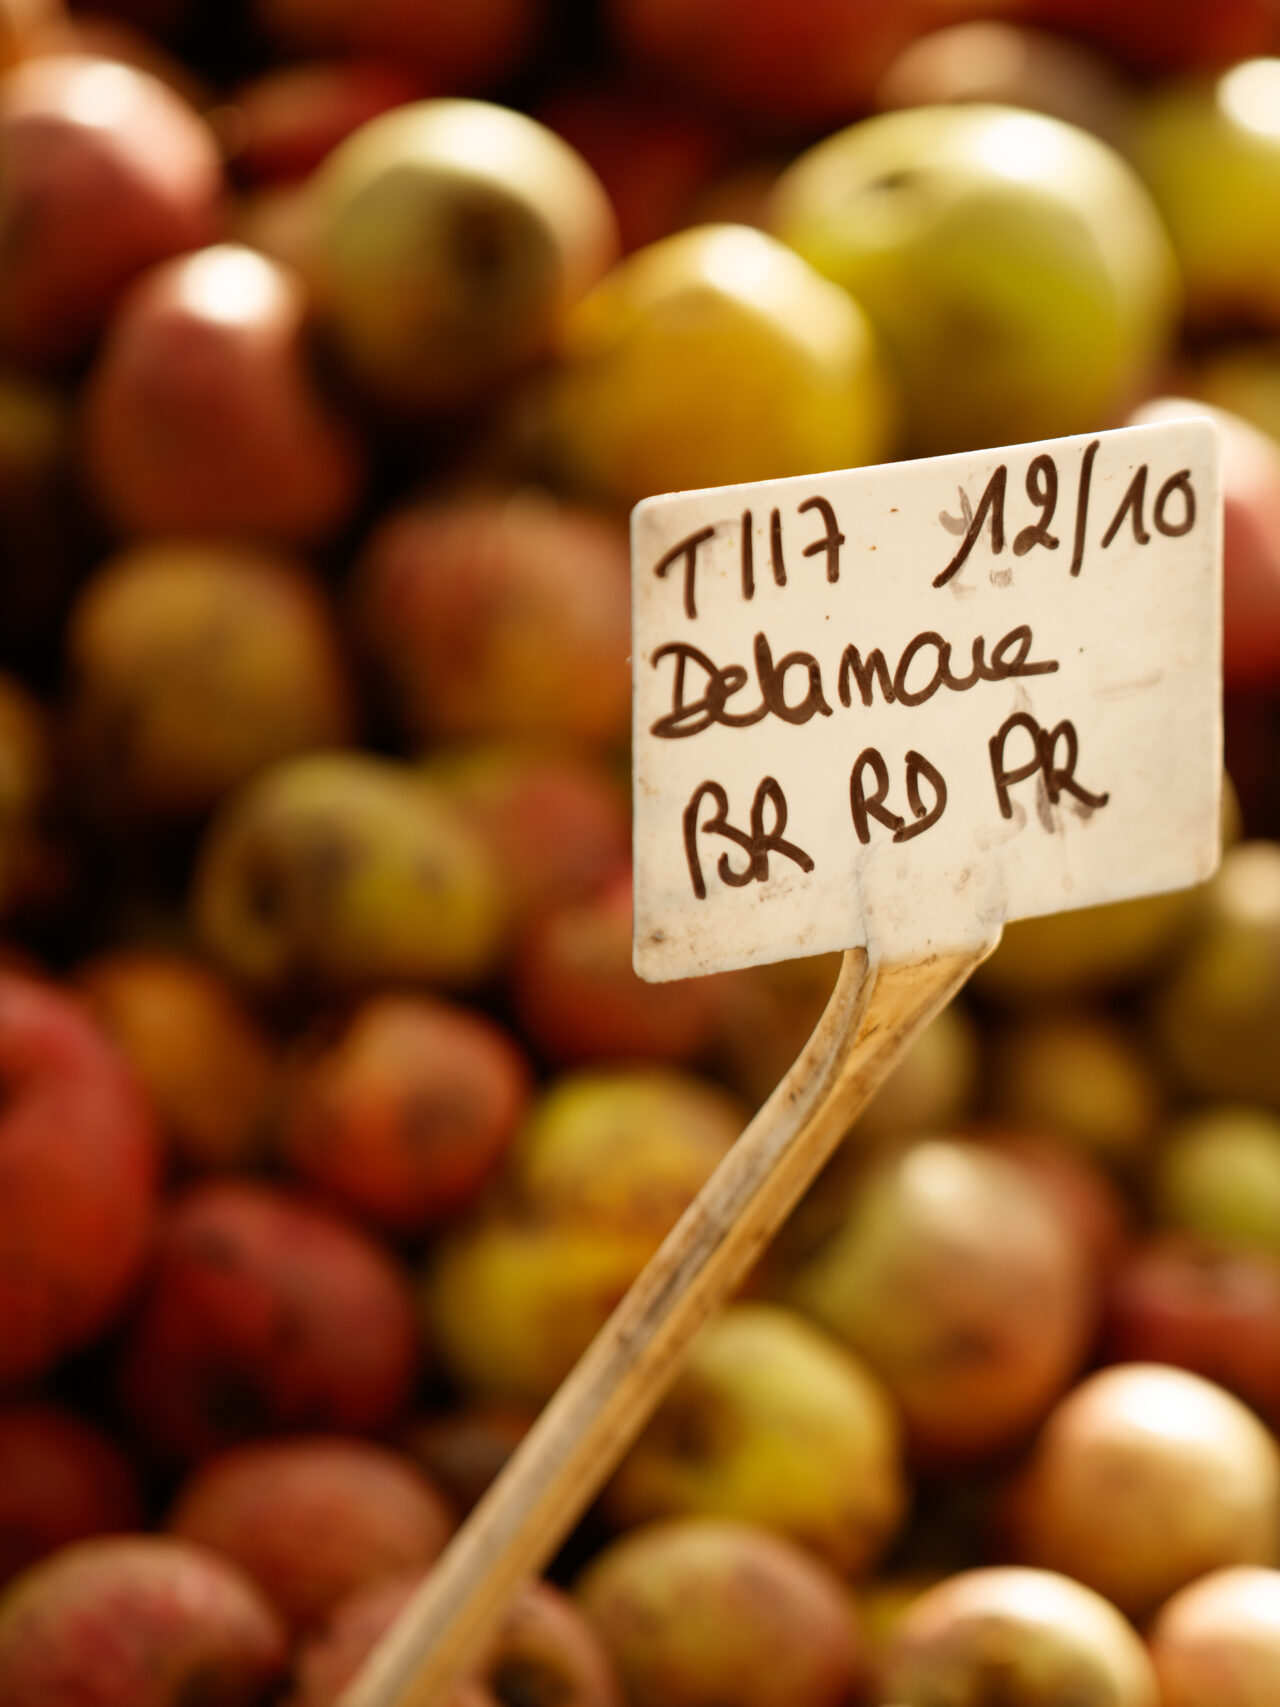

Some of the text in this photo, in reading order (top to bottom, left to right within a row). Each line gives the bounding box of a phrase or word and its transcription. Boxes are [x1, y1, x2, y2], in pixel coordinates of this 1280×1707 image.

[932, 440, 1197, 588] 12/10
[683, 711, 1110, 900] BR RD PR
